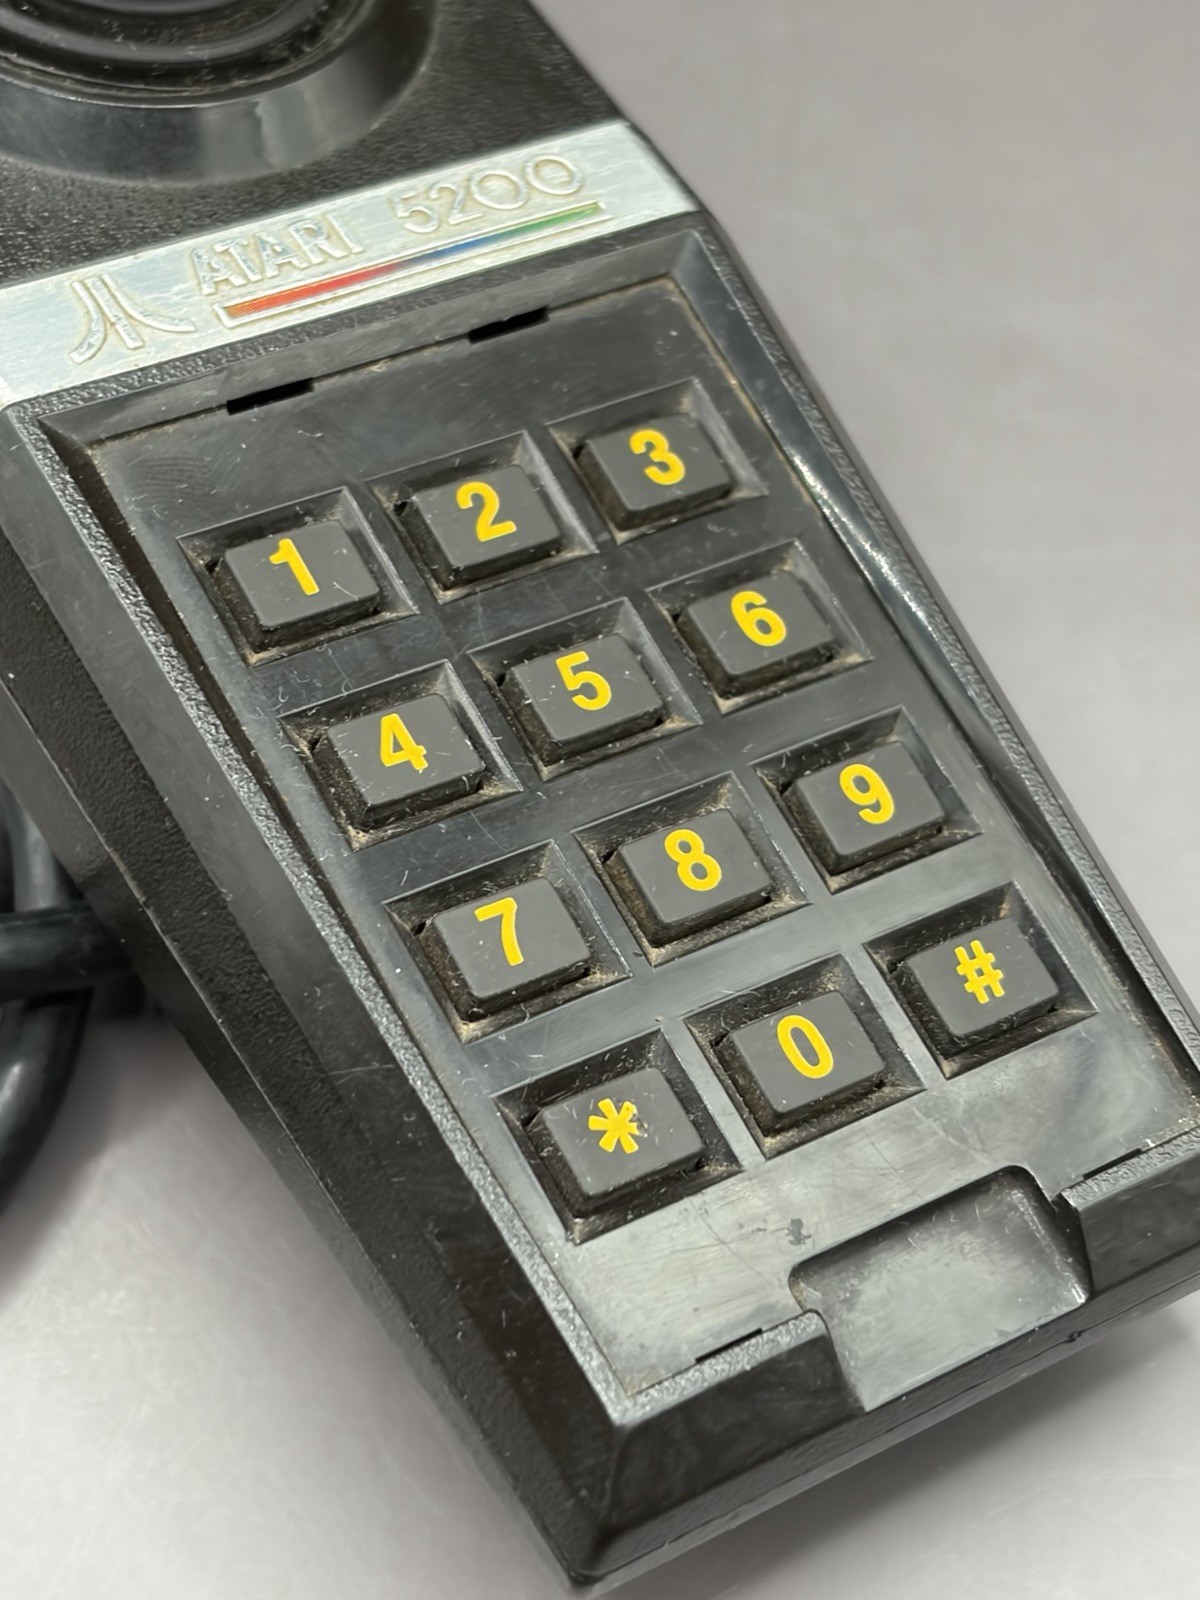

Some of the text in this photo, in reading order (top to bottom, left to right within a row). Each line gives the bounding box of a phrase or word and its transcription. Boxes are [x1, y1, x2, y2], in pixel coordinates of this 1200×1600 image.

[191, 154, 584, 294] ATARI 5200
[628, 428, 684, 485] 3
[455, 480, 514, 541] 2
[268, 538, 317, 597] 1
[729, 590, 787, 647] 6
[554, 650, 611, 712] 5
[379, 713, 427, 773] 4
[838, 763, 894, 825] 9
[663, 828, 721, 892] 8
[474, 897, 523, 966] 7
[954, 939, 1004, 1003] #
[776, 1013, 833, 1079] 0
